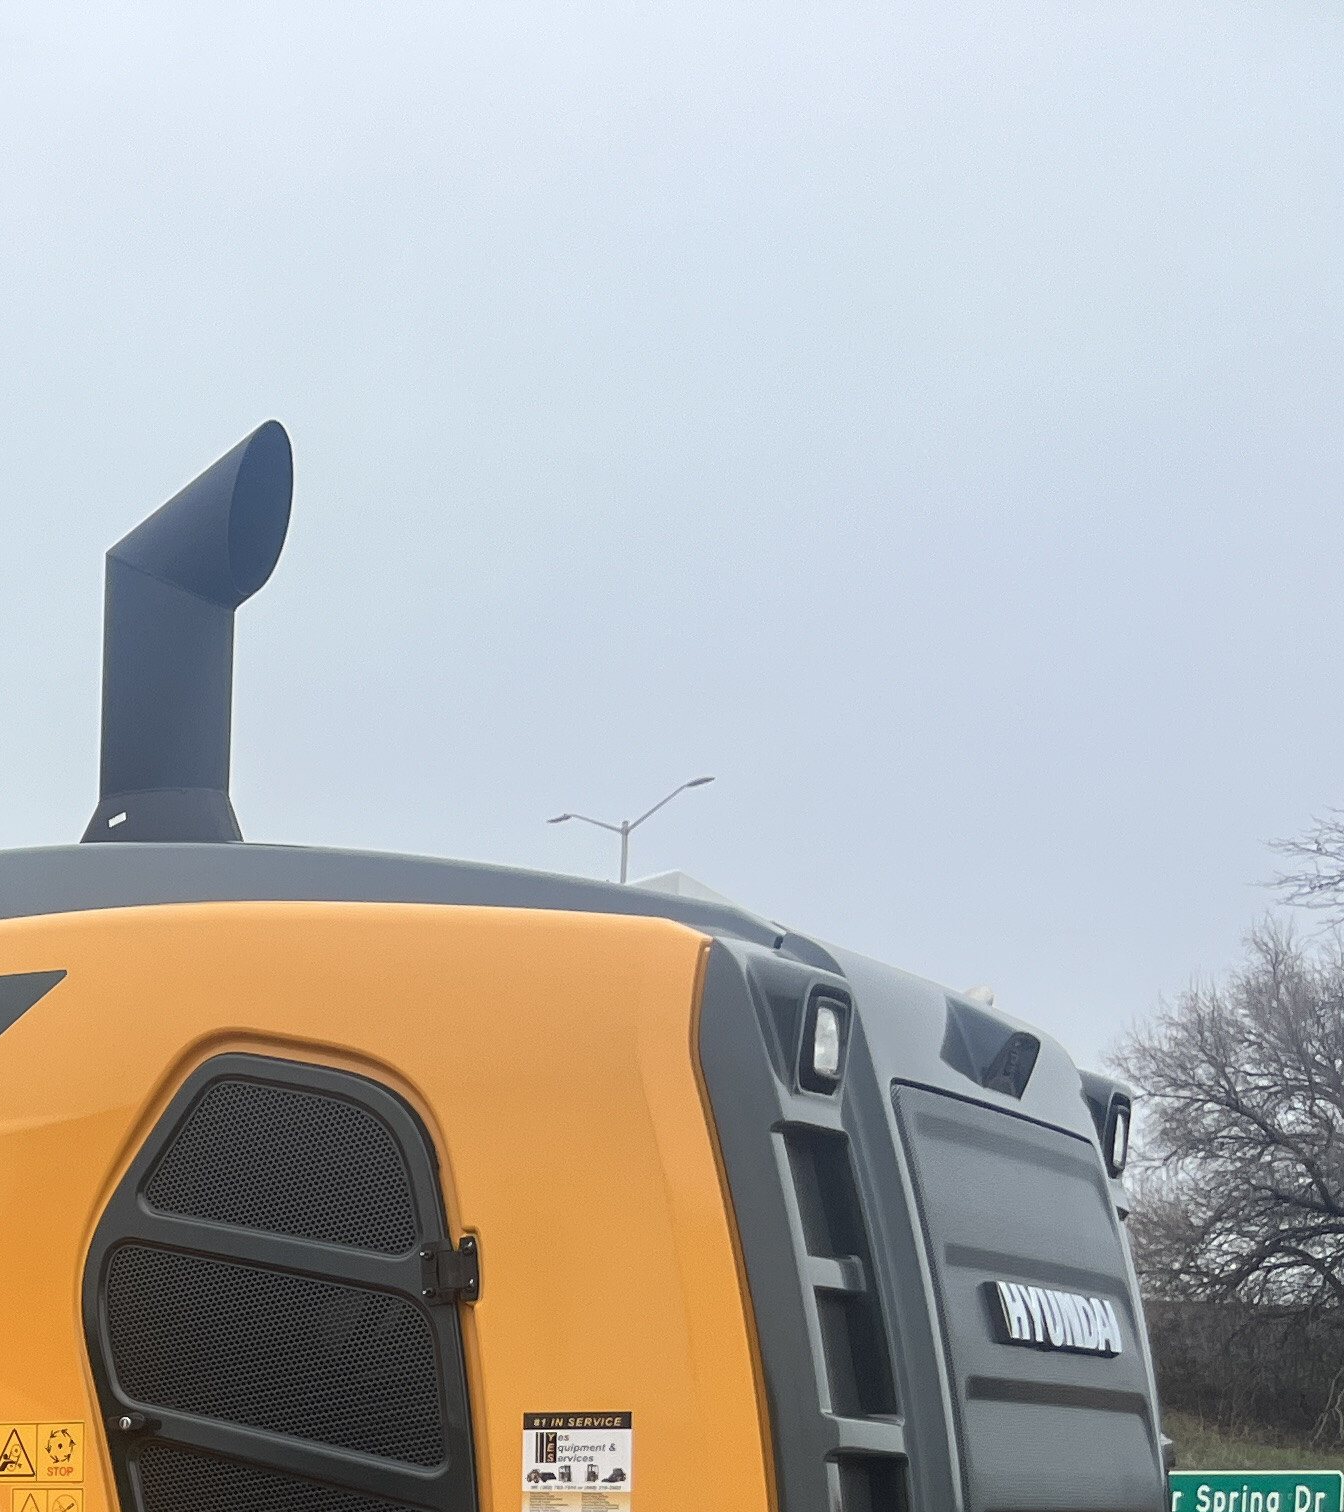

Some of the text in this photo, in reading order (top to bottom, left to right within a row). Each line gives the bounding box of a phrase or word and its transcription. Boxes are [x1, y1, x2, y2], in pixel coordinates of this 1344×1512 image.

[996, 1280, 1122, 1353] HYUNDAI
[551, 1418, 563, 1427] IN
[568, 1417, 622, 1427] SERVICE
[47, 1466, 73, 1477] STOP
